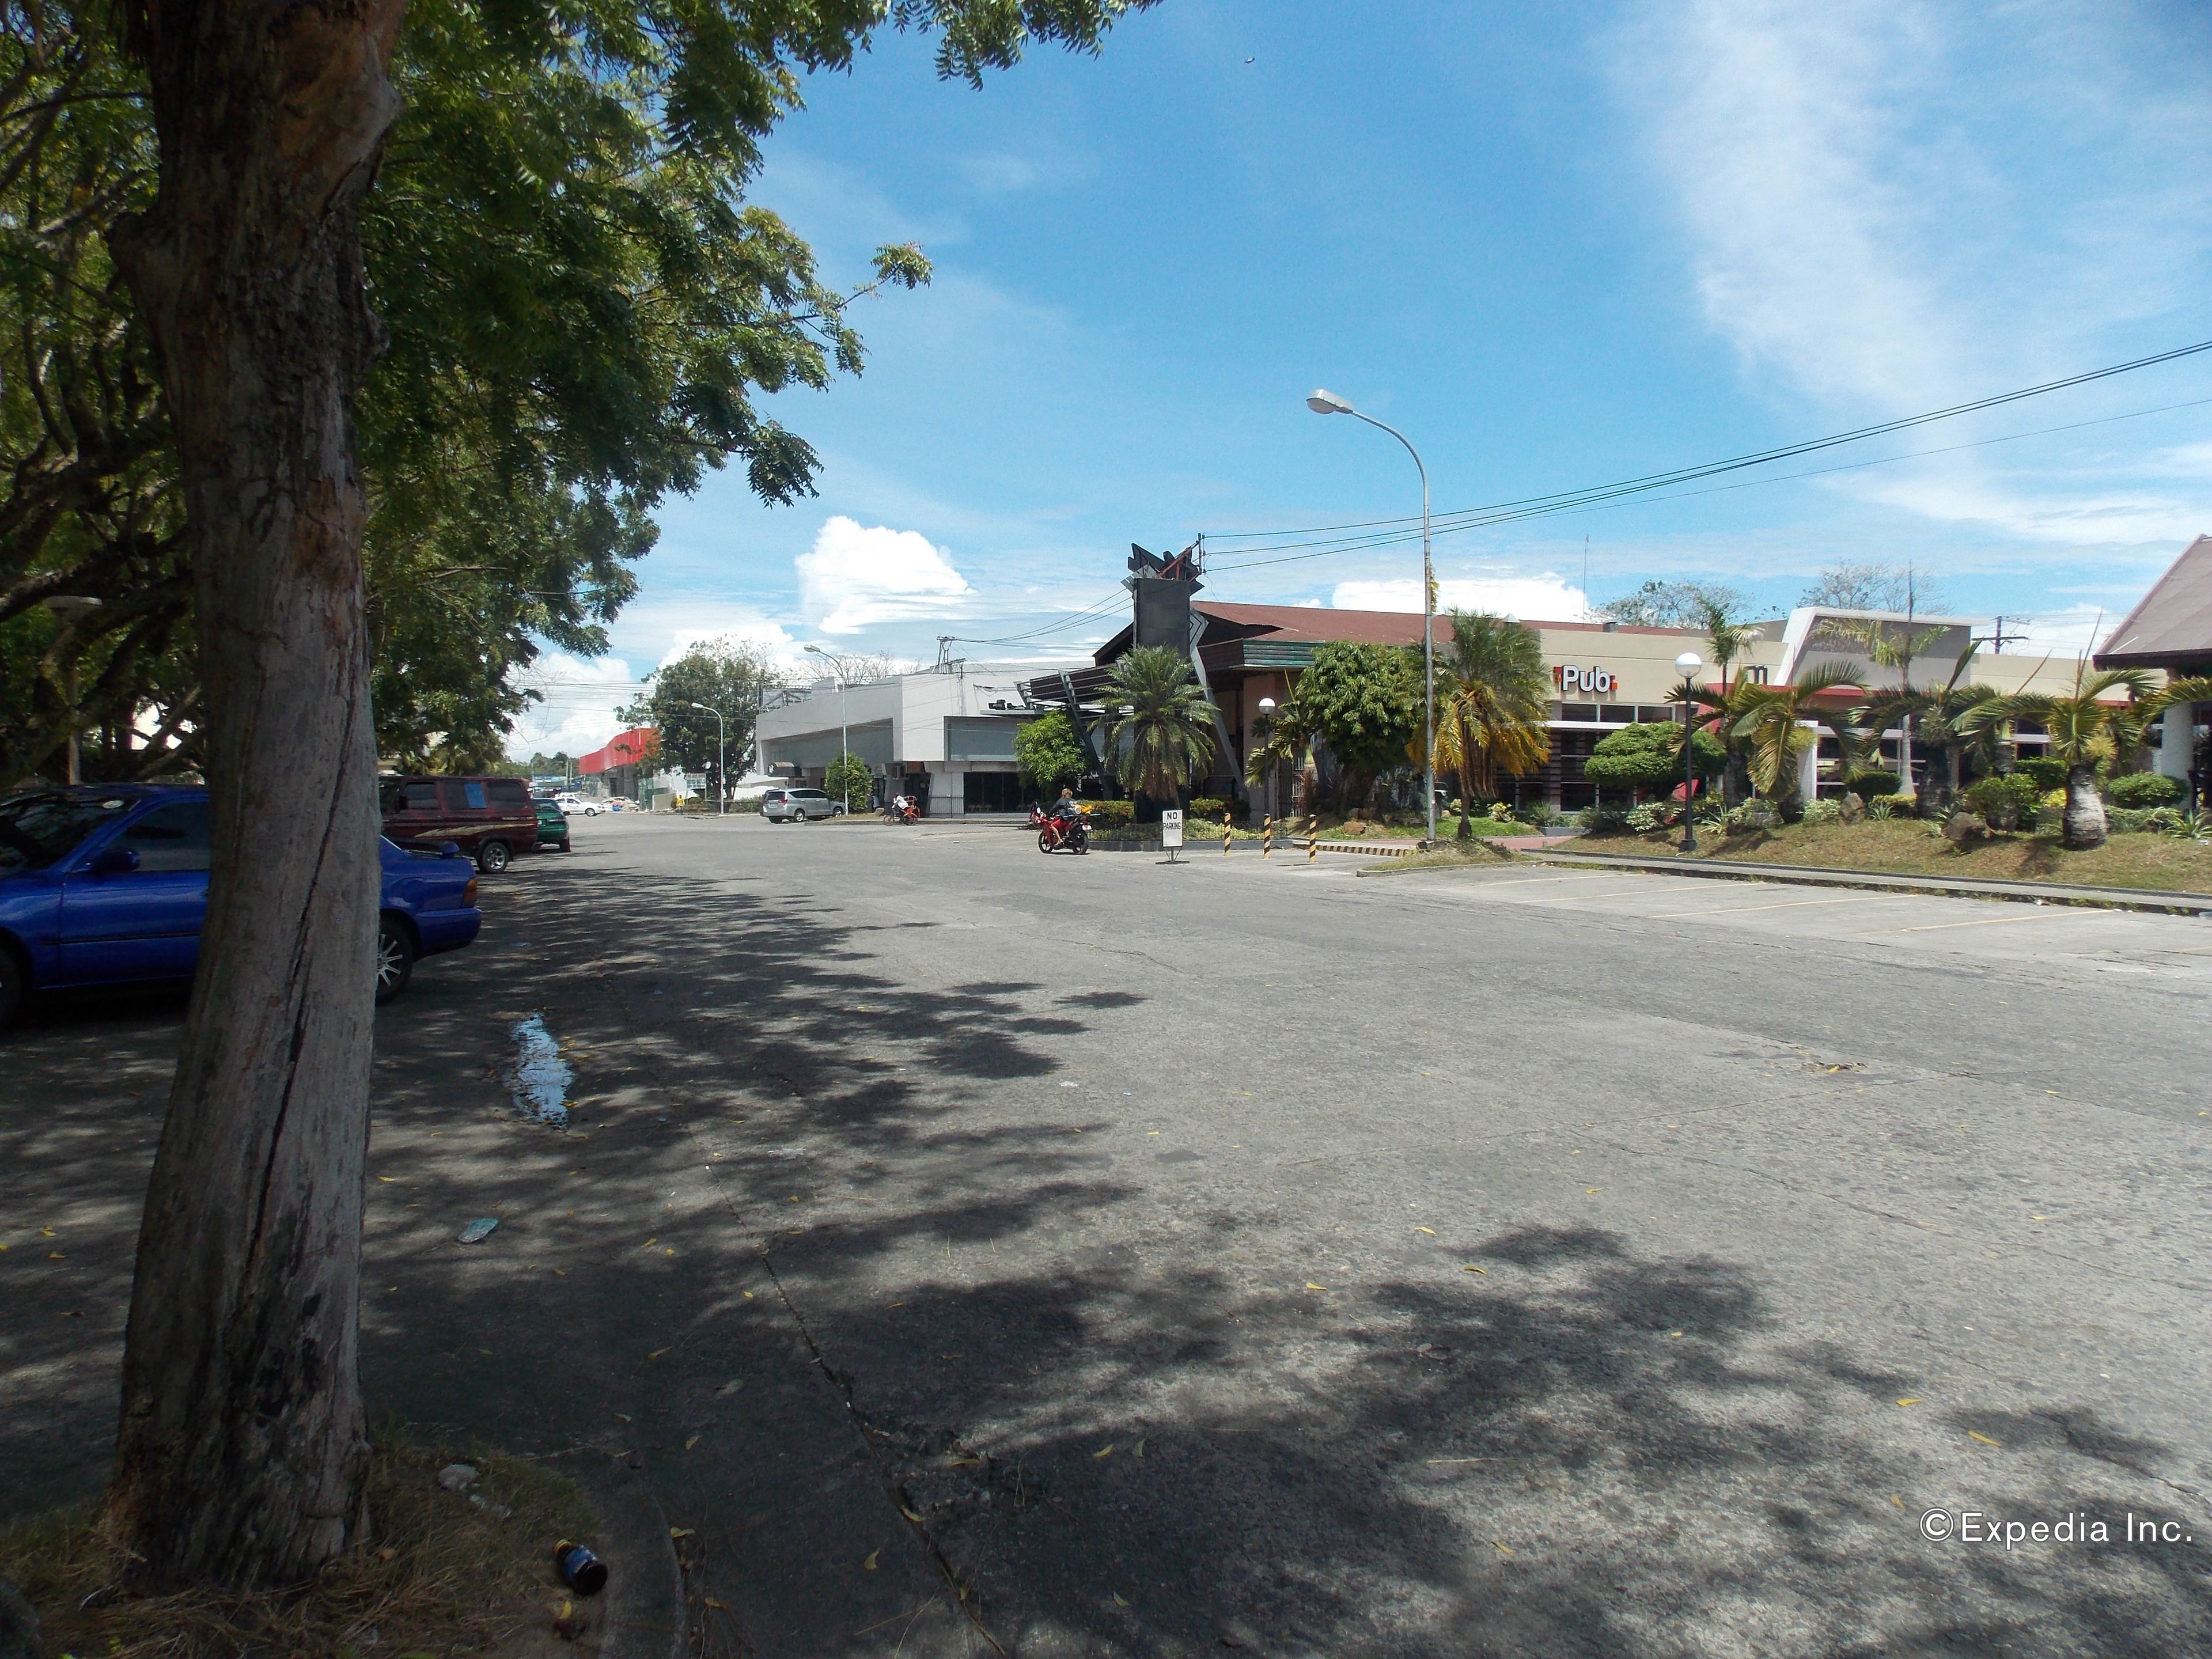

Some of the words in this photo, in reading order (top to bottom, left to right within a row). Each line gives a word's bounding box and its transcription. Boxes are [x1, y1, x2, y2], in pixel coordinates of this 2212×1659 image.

[1562, 665, 1610, 693] Pub
[1166, 812, 1177, 820] NO
[1163, 822, 1181, 830] PARKING
